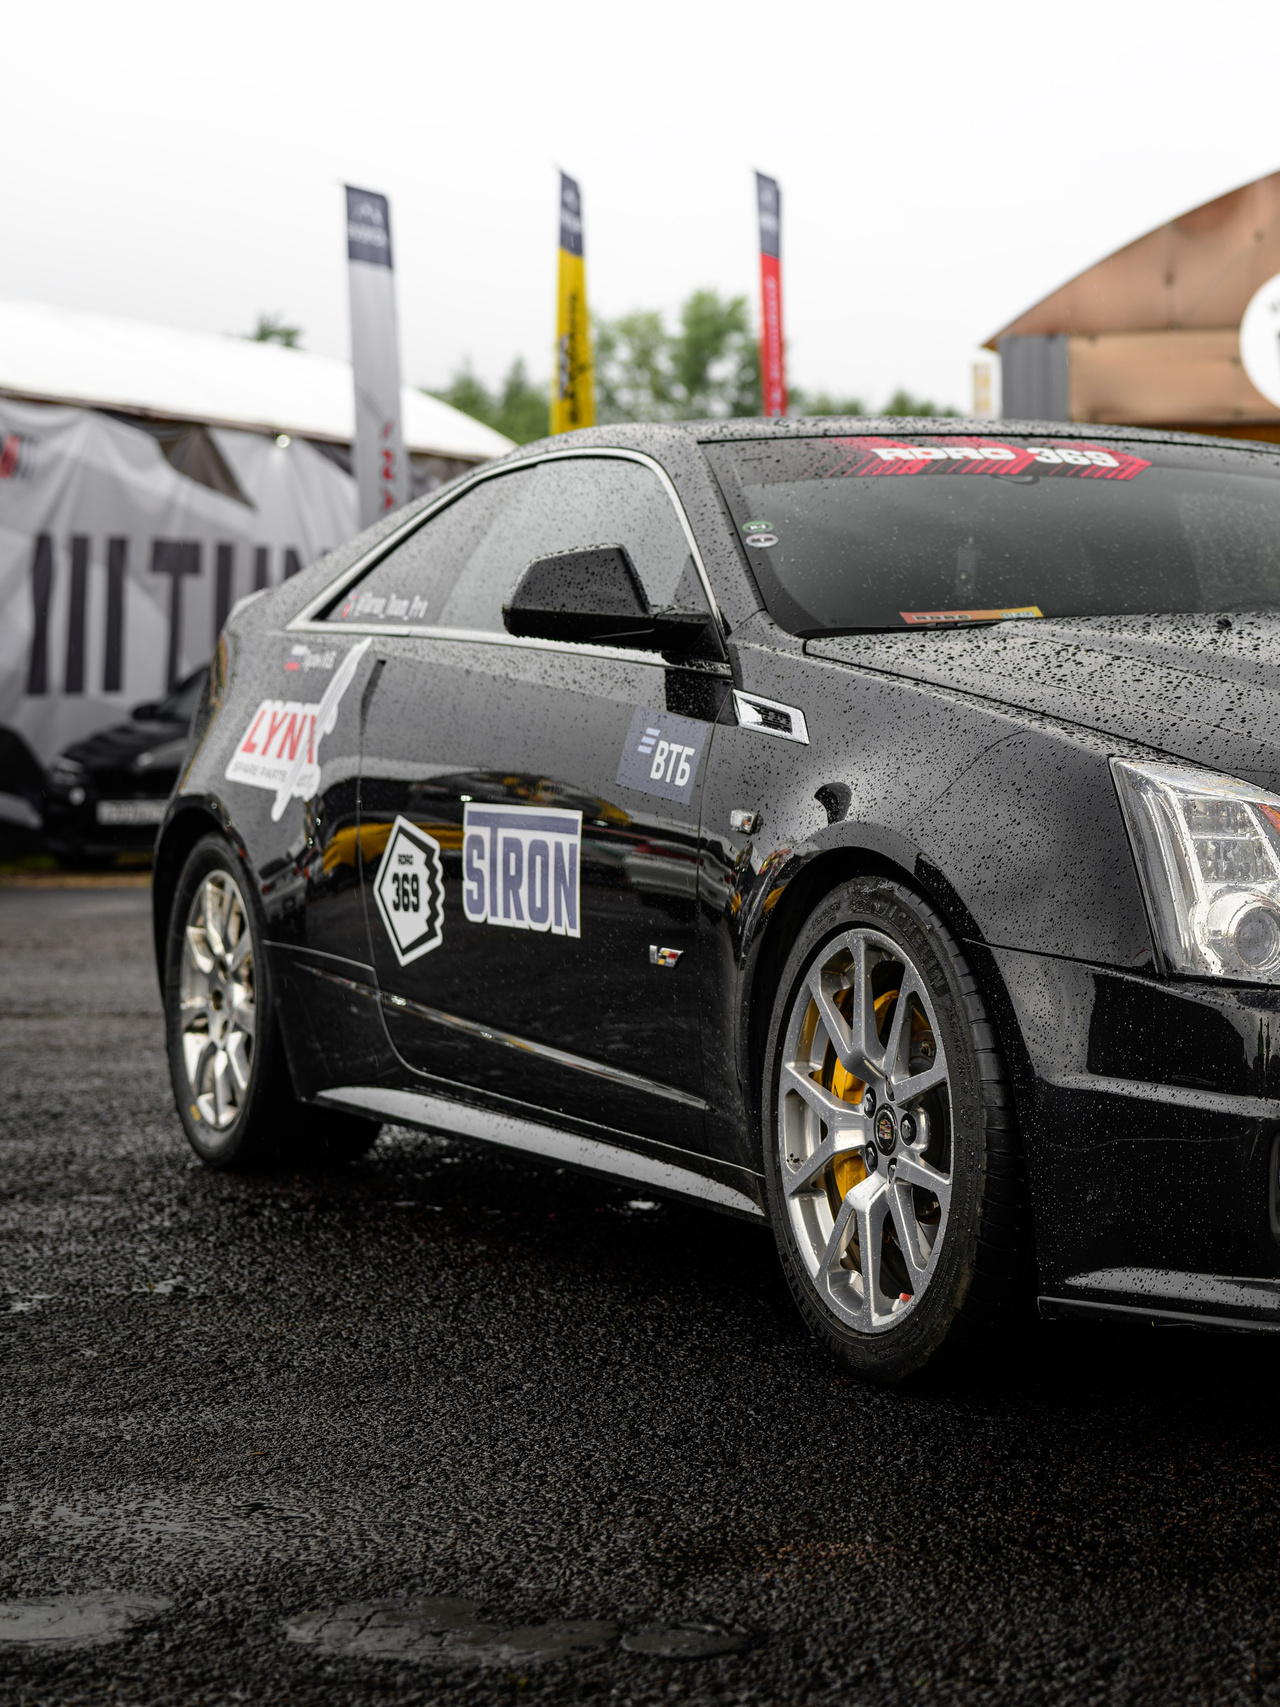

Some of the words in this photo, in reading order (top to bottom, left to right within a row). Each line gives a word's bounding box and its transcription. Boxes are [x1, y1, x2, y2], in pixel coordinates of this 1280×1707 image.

[1026, 446, 1120, 467] 369
[241, 709, 317, 765] LYNX
[650, 740, 696, 787] ВТБ
[392, 873, 420, 912] 369
[465, 811, 579, 931] STRON
[871, 897, 946, 988] MICHELIN
